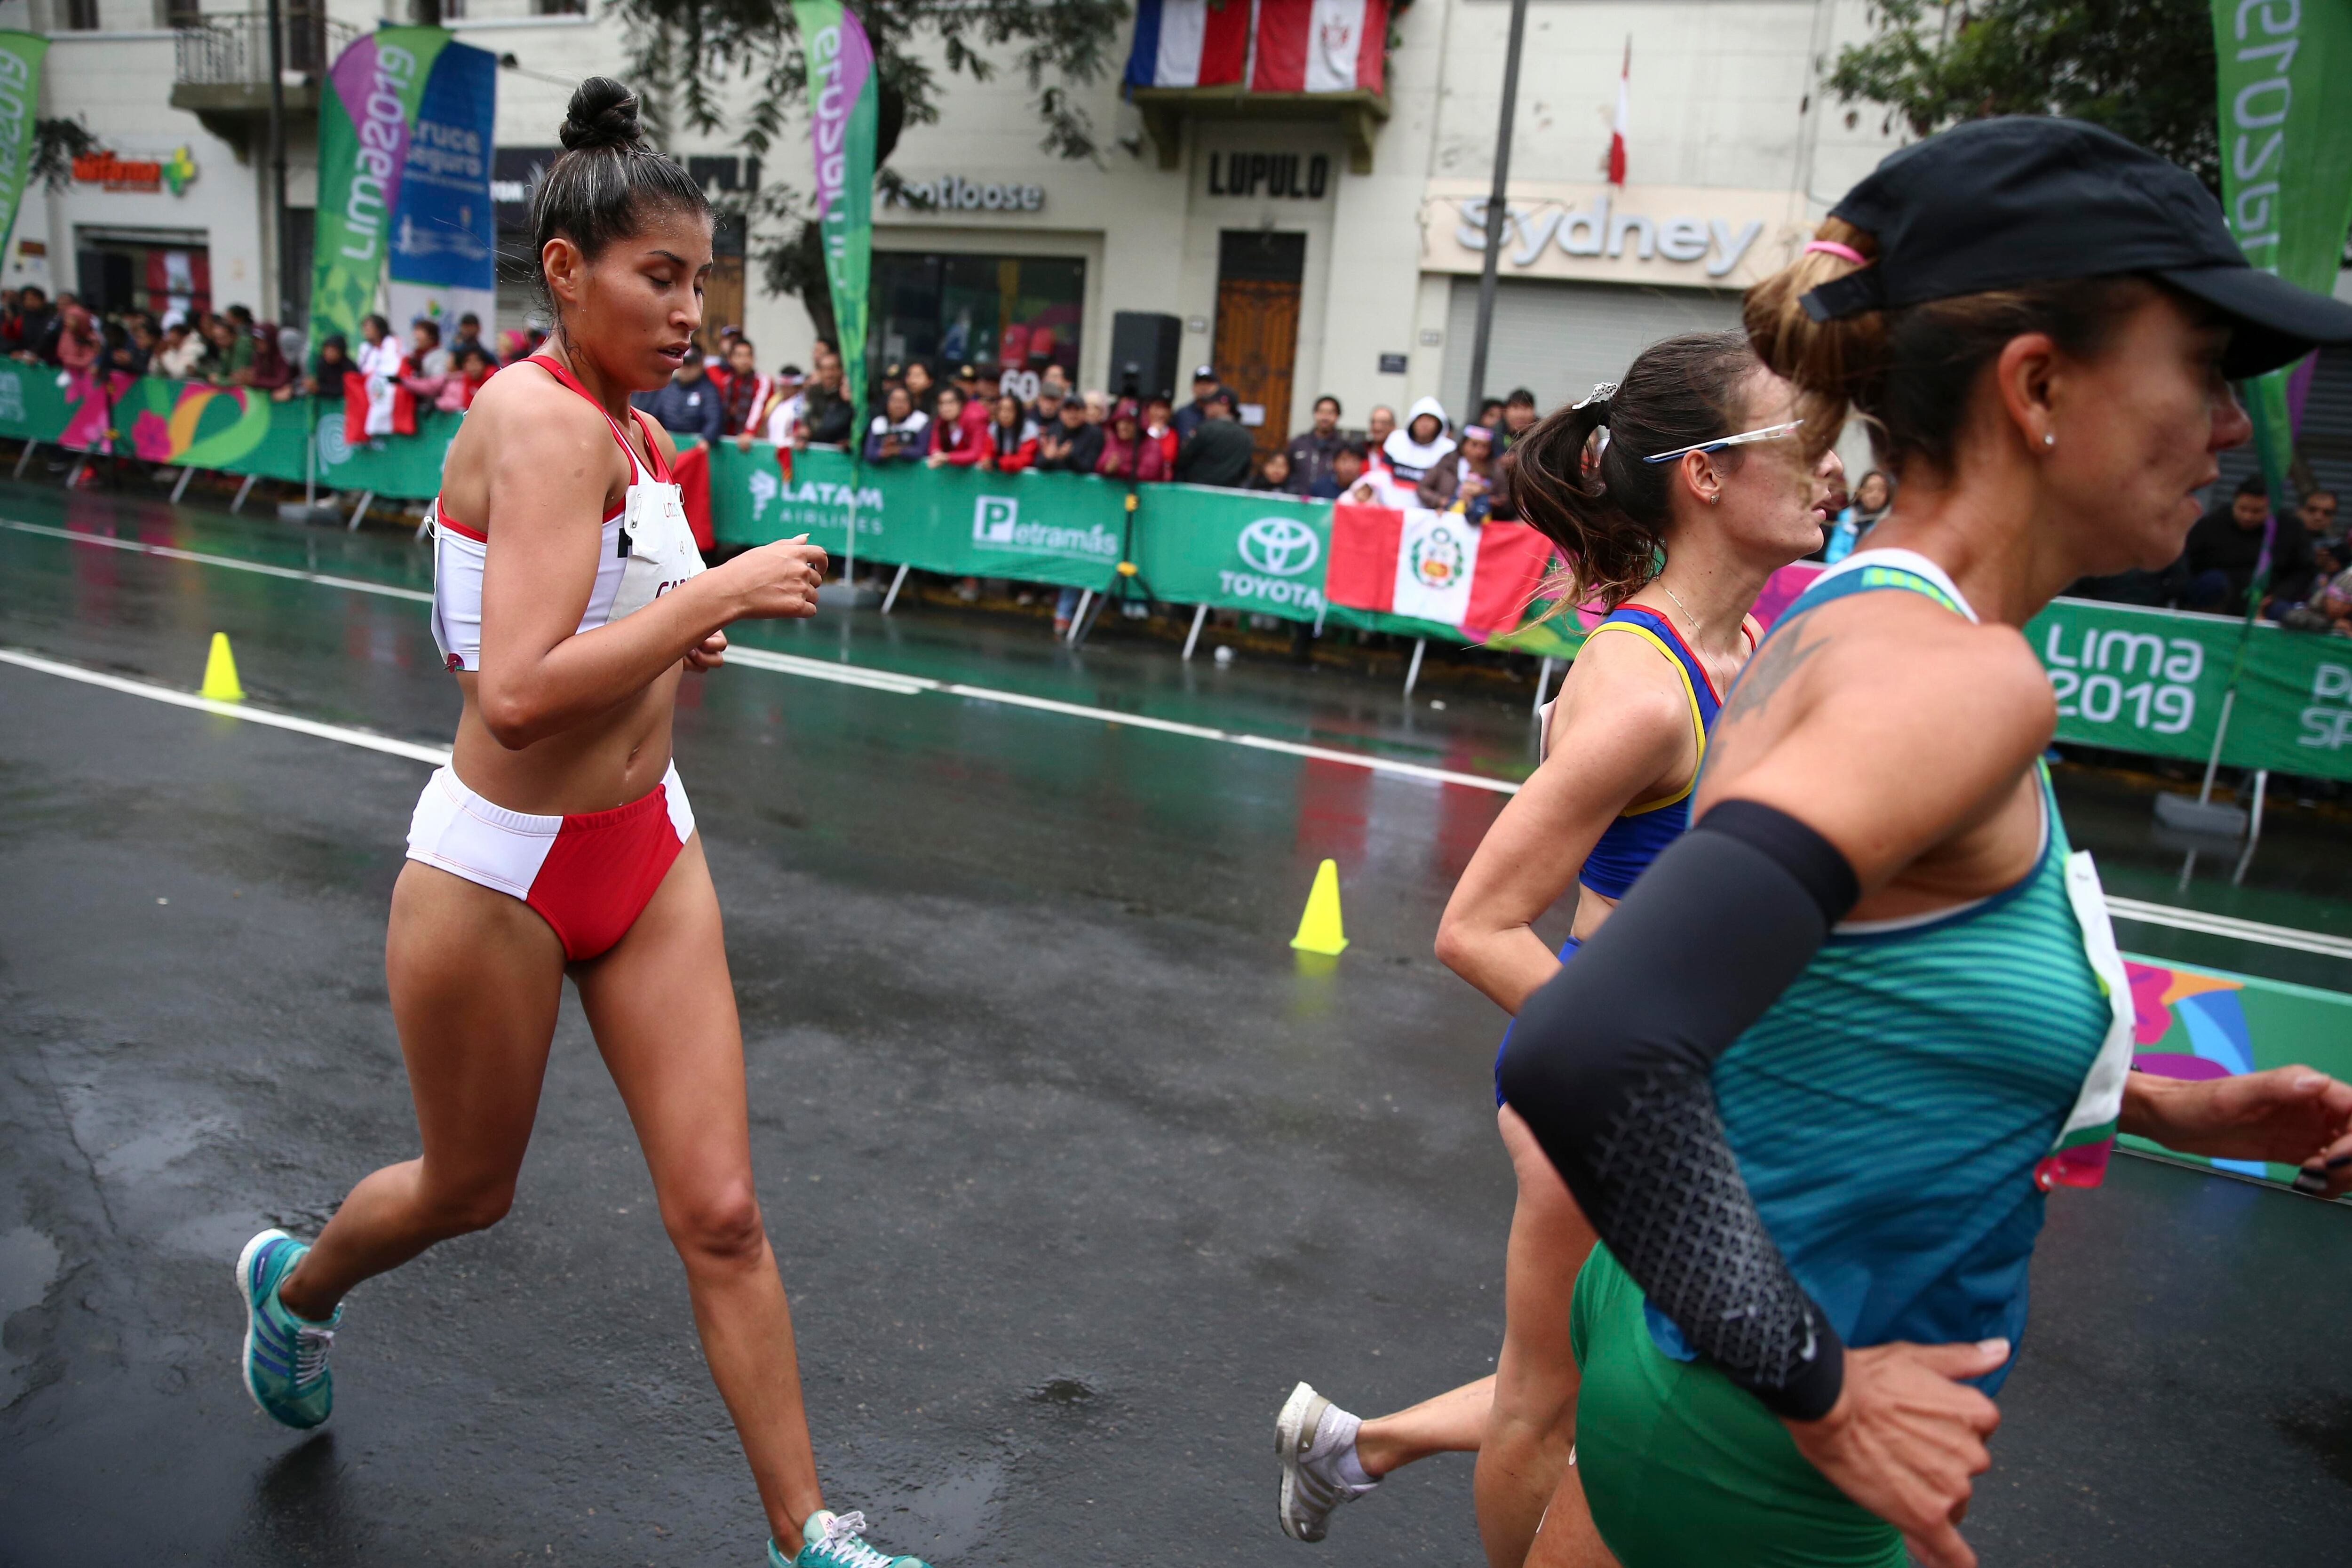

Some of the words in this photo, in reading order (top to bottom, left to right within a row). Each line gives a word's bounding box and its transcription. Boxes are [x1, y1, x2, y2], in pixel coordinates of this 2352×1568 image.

[1454, 195, 1764, 277] Sydney
[781, 480, 884, 512] LATAM
[779, 508, 884, 535] AIRLINES
[1219, 570, 1321, 612] TOYOTA
[2048, 669, 2196, 734] 2019
